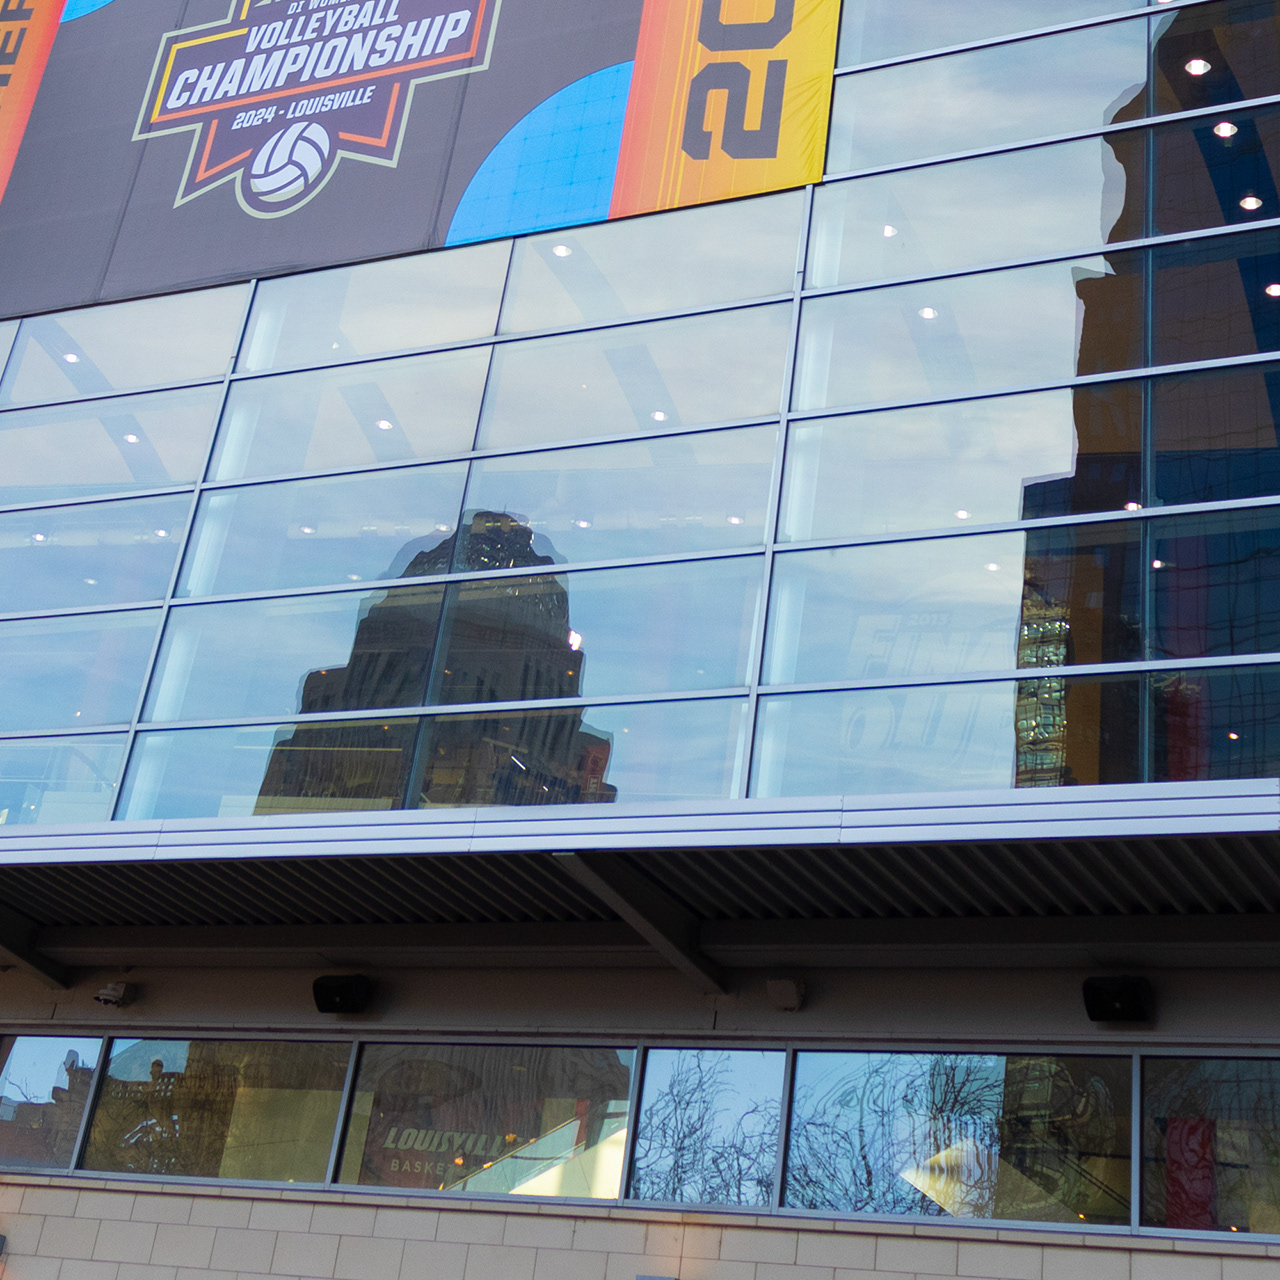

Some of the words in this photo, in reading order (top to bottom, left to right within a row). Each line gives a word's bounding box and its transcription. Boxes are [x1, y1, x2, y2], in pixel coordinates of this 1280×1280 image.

[287, 1, 304, 15] DI
[166, 9, 472, 110] CHAMPIONSHIP
[231, 105, 277, 131] 2024
[286, 85, 376, 120] LOUISVILLE
[382, 1127, 524, 1157] LOUISVILL
